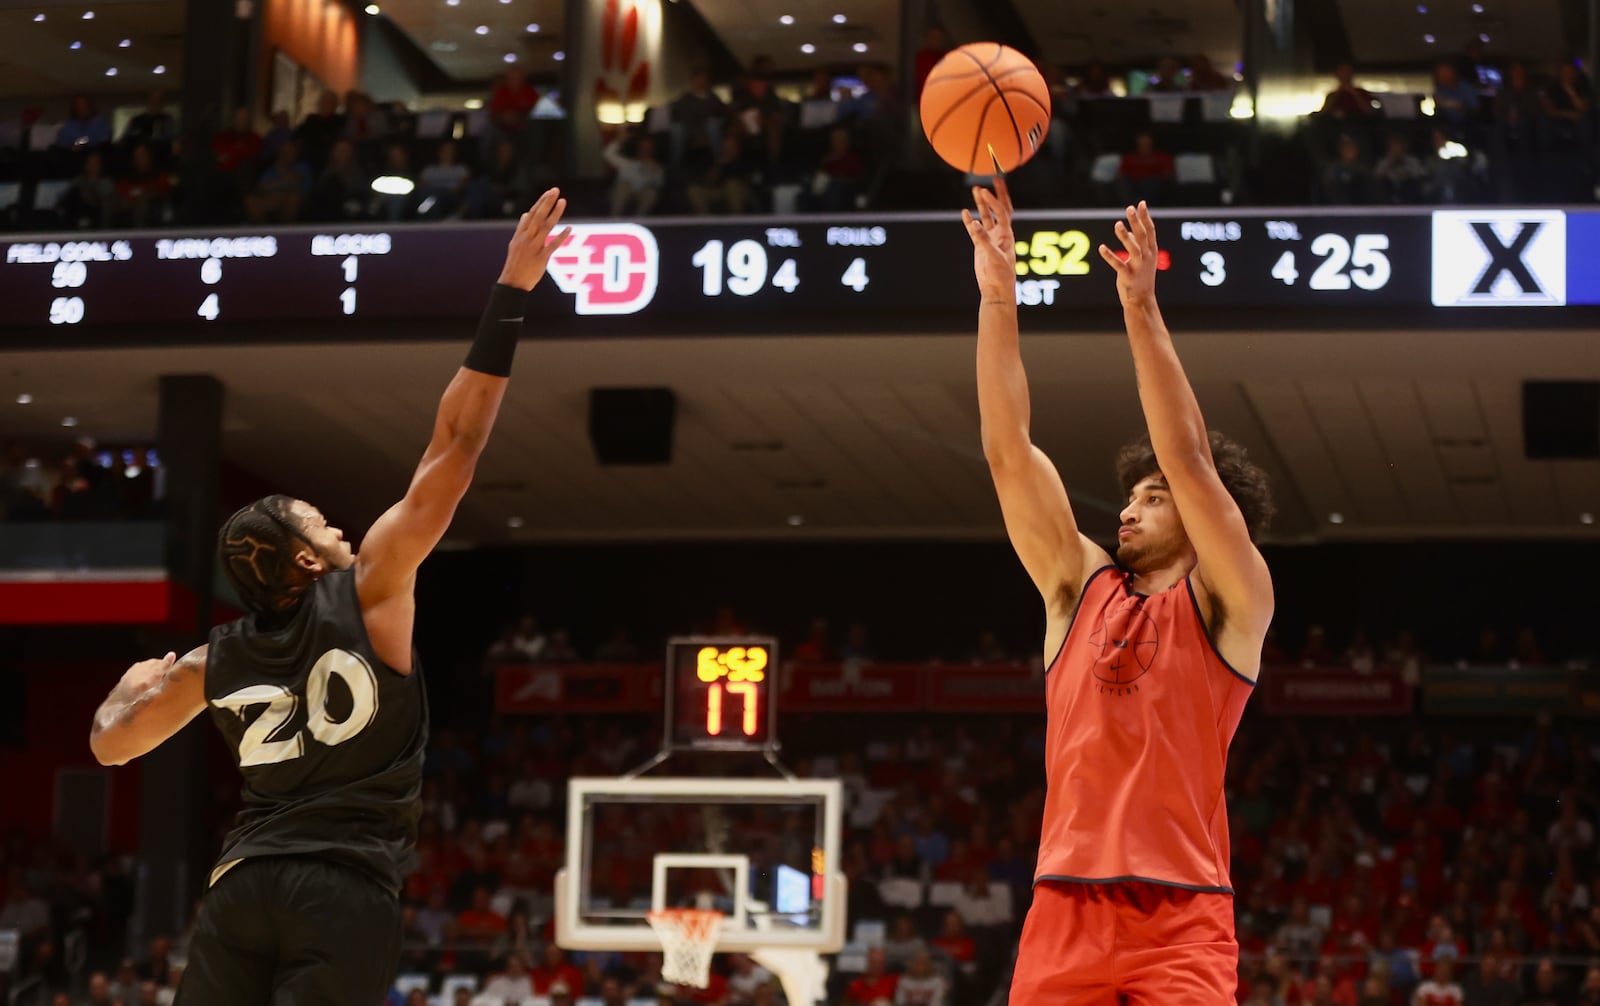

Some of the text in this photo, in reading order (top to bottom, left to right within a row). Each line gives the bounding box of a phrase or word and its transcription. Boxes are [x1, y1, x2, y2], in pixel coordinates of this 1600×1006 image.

[156, 236, 277, 259] TURNOVERS
[311, 233, 391, 255] BLOCKS
[766, 228, 800, 247] TOL
[827, 227, 886, 246] FOULS
[1181, 222, 1241, 241] FOULS
[1265, 221, 1301, 240] TOL
[7, 243, 60, 263] FIELD
[60, 241, 111, 262] GOAL
[342, 256, 358, 282] 1
[693, 239, 768, 295] 19
[1016, 230, 1090, 275] :52
[1200, 251, 1226, 287] 3
[1271, 250, 1299, 285] 4
[1309, 233, 1391, 290] 25
[1463, 220, 1545, 295] X
[772, 259, 799, 293] 4
[841, 258, 869, 292] 4
[197, 293, 219, 320] 4
[340, 287, 356, 314] 1
[697, 647, 767, 682] 6:52
[211, 648, 379, 767] 20
[707, 682, 758, 735] 17
